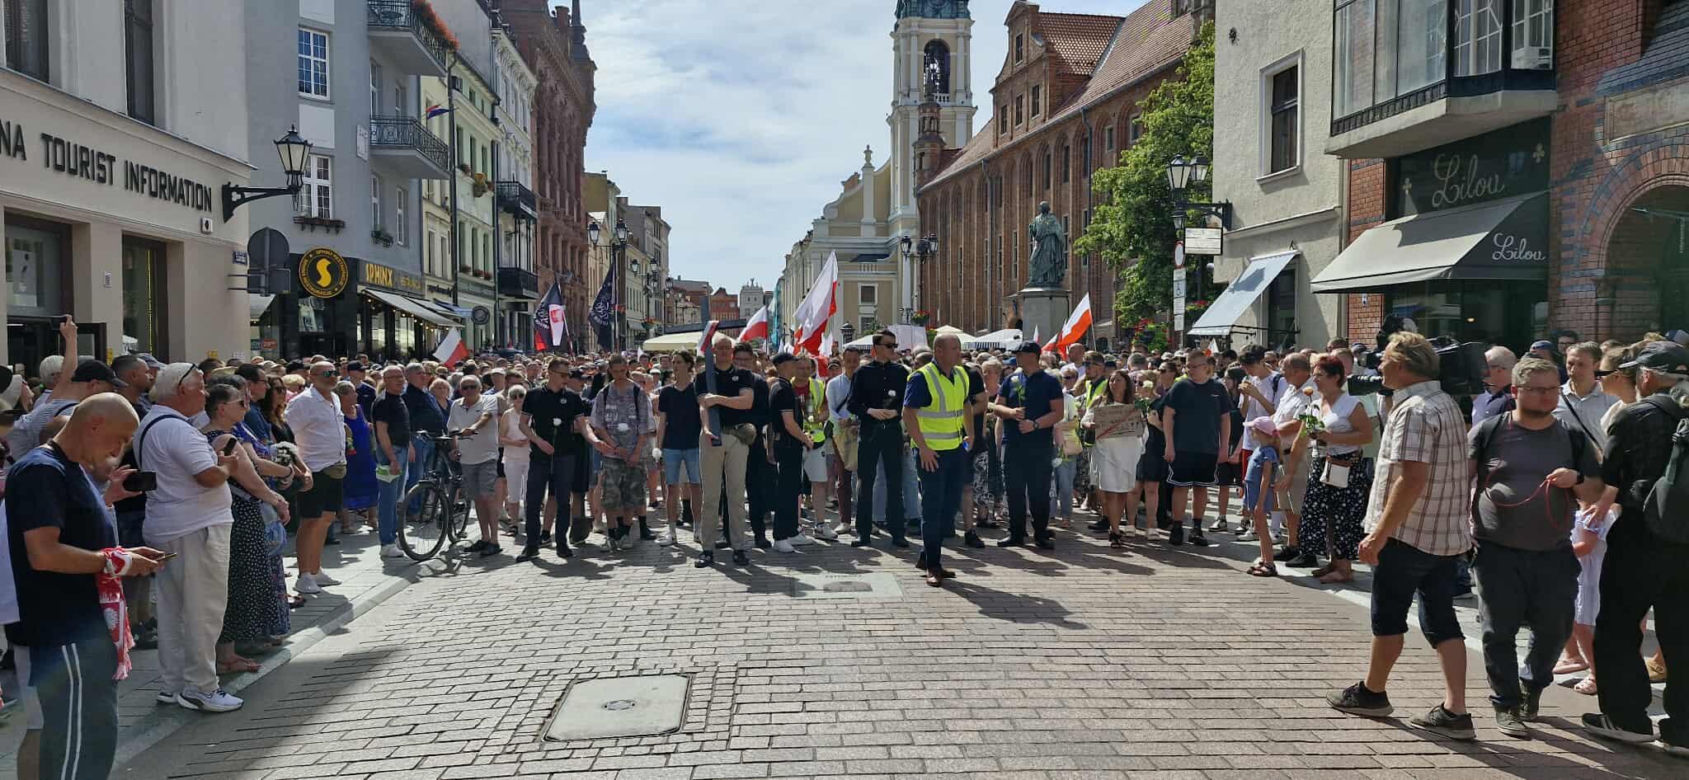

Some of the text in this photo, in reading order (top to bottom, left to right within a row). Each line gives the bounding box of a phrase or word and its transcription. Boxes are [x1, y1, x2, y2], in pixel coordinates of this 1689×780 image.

[40, 132, 116, 186] TOURIST
[124, 160, 212, 212] INFORMATION
[1432, 153, 1505, 208] Lilou
[1492, 232, 1546, 261] Lilou
